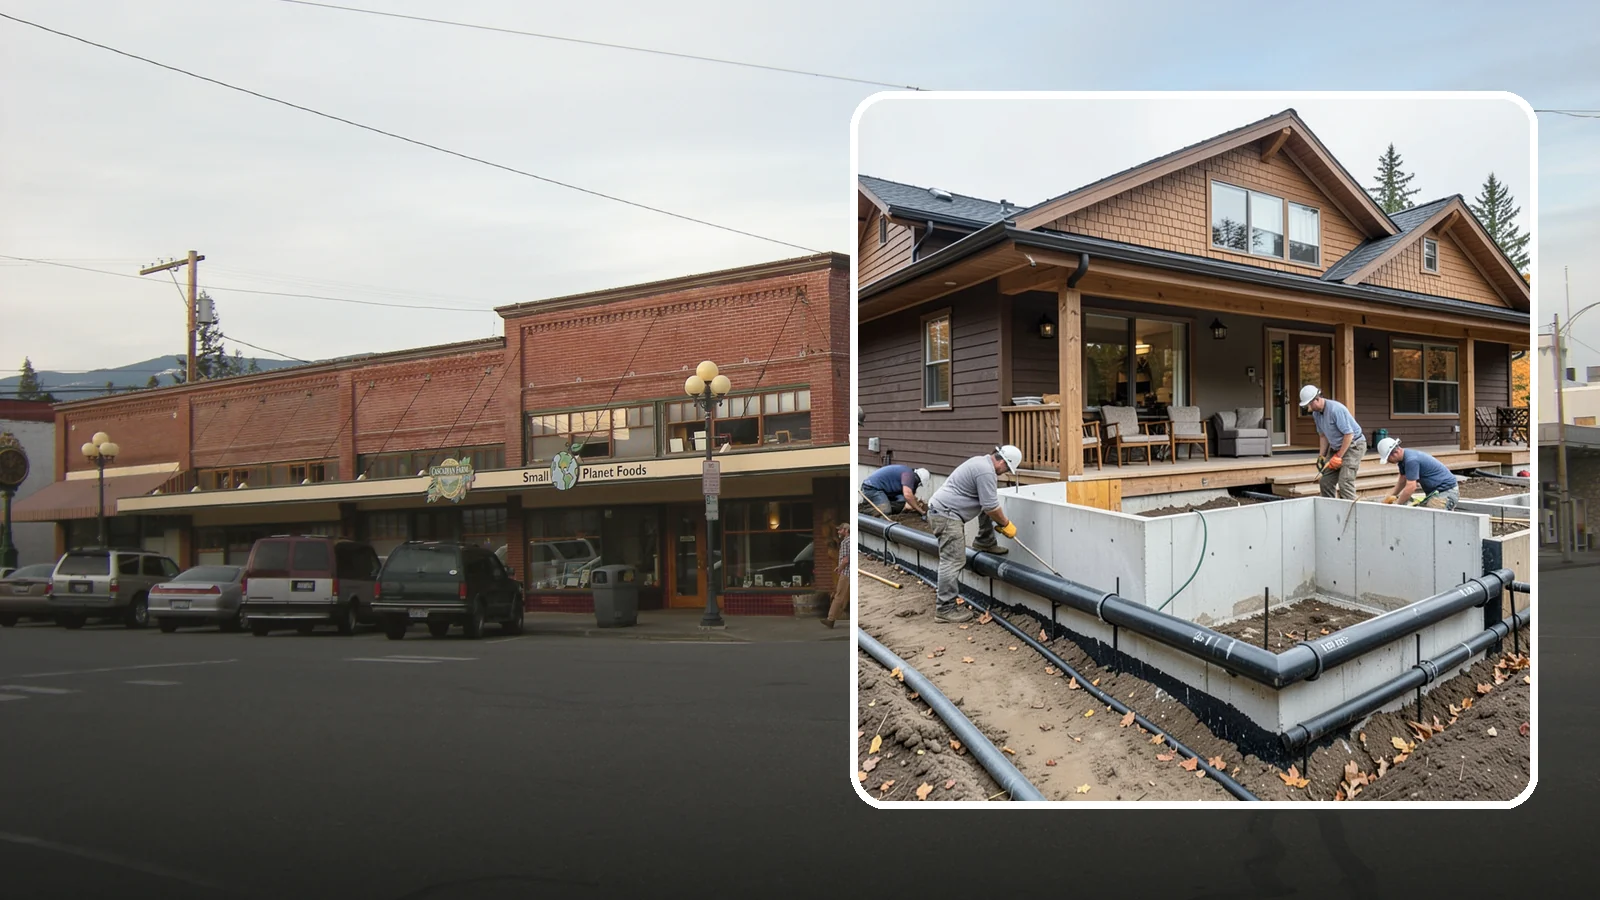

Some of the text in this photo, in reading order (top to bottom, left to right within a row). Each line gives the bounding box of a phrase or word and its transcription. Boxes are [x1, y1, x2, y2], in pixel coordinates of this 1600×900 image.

[432, 467, 456, 476] CASCADIAN
[523, 464, 647, 483] Small Planet Foods
